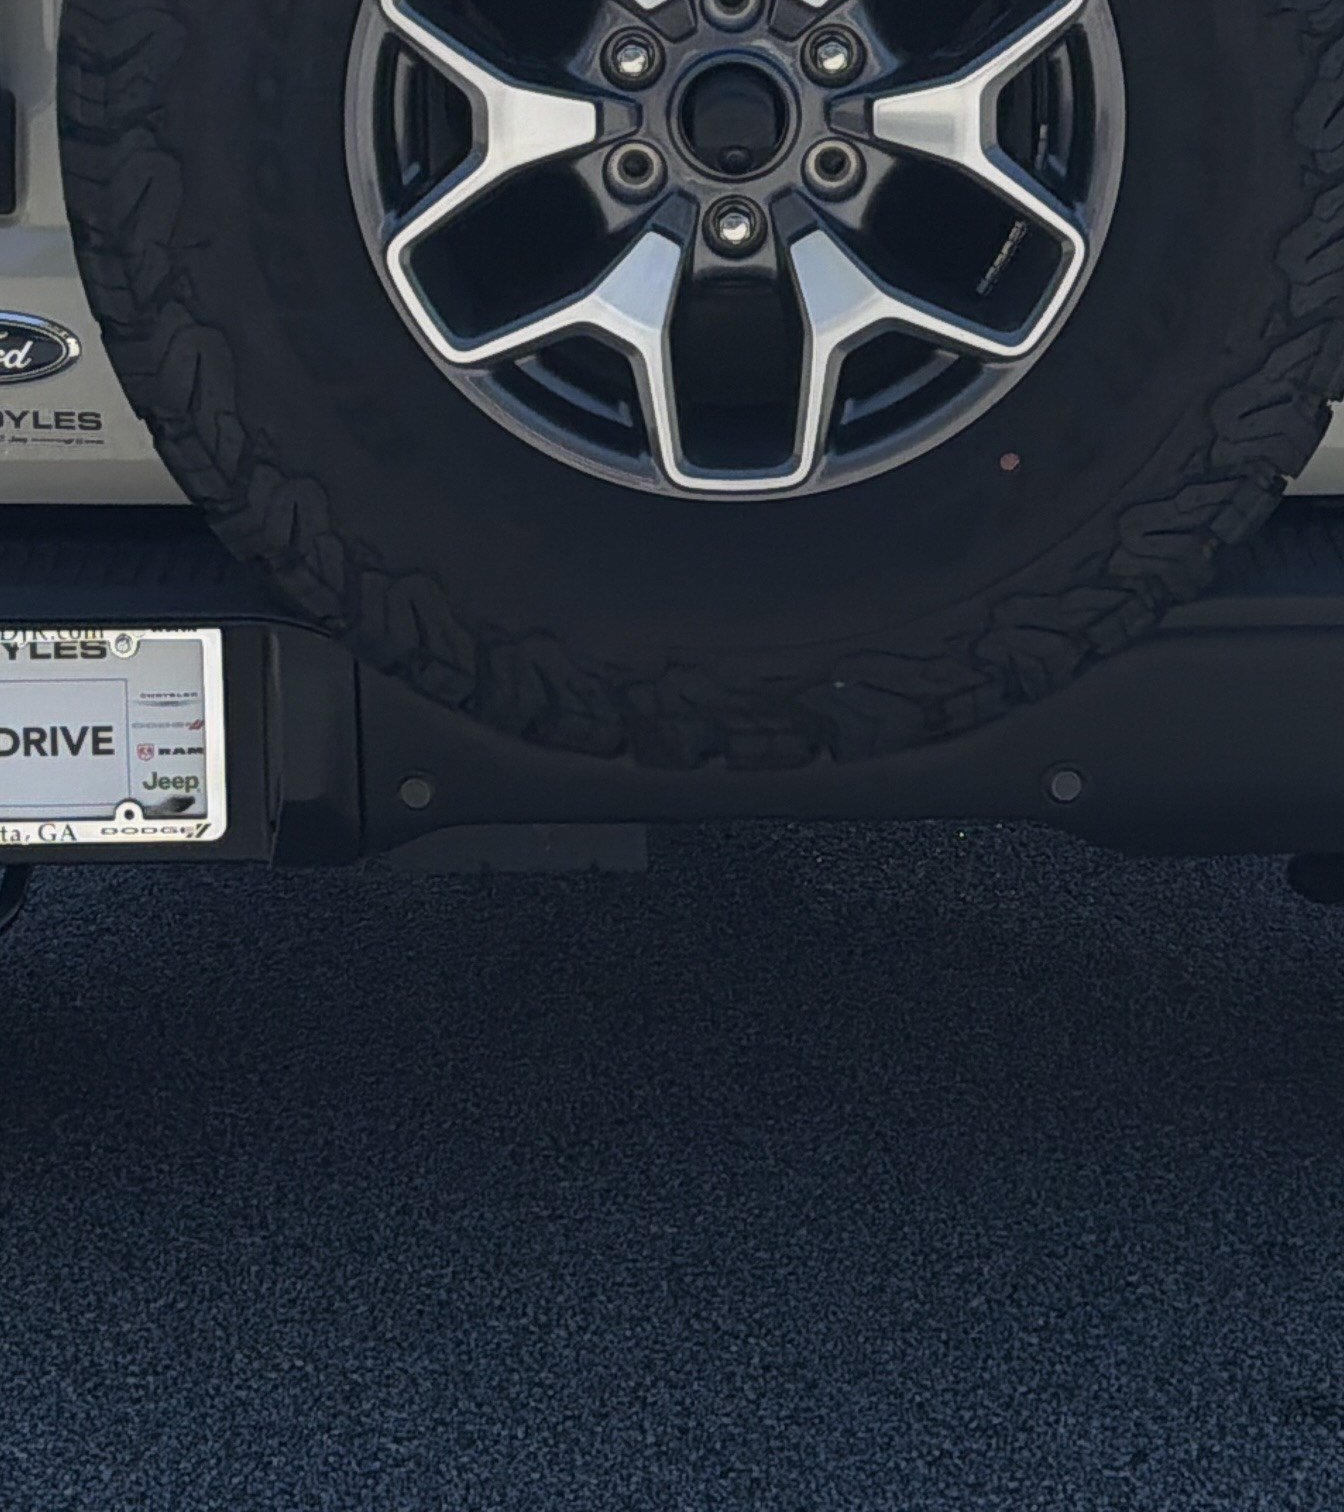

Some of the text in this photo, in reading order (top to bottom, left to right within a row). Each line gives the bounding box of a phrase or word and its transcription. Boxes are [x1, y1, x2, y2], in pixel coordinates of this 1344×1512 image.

[158, 747, 203, 756] RAM
[142, 771, 199, 794] Jeep
[38, 822, 77, 843] GA
